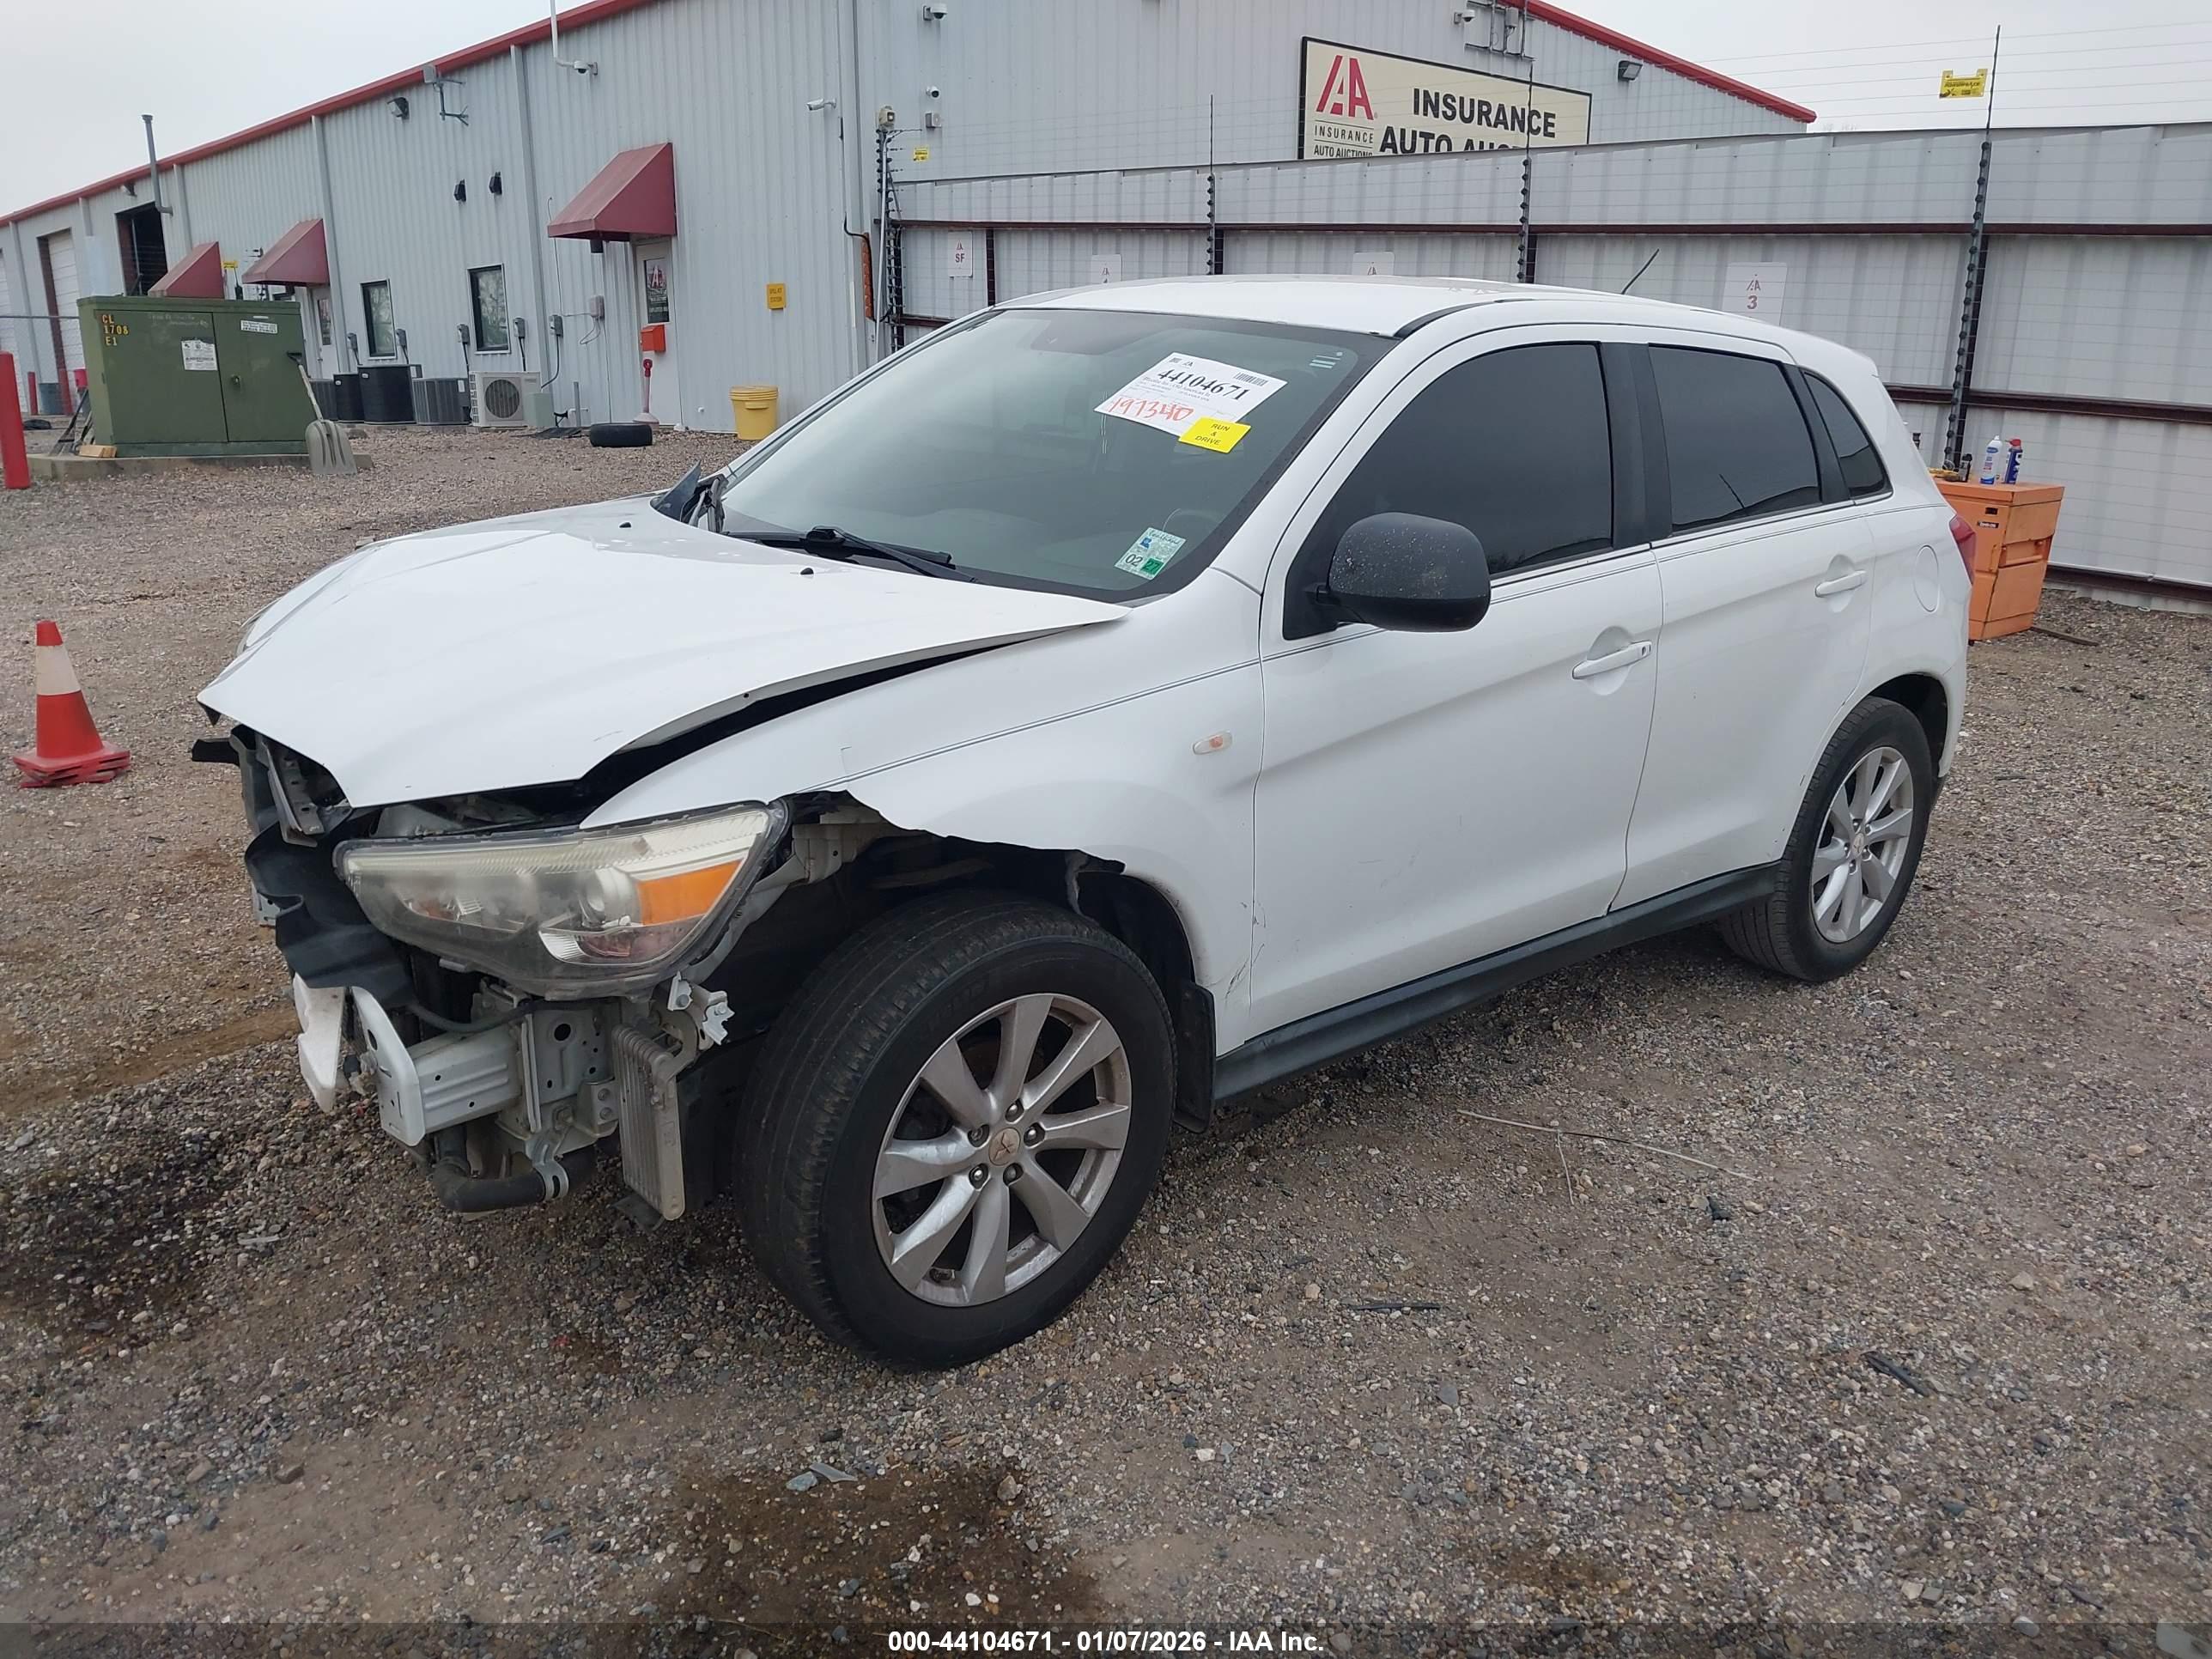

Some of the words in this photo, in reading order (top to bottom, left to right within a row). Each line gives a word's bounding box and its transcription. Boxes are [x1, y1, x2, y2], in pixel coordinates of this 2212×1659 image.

[1413, 88, 1556, 138] INSURANCE
[1315, 125, 1374, 144] INSURANCE
[1379, 125, 1453, 155] AUTO
[1314, 144, 1334, 158] AUTO
[955, 253, 965, 263] SF
[1747, 295, 1758, 309] 3
[102, 314, 114, 324] CL
[104, 325, 129, 335] 1708
[106, 336, 118, 346] E1
[1158, 368, 1251, 401] 44104671
[1211, 423, 1231, 432] RUN
[1194, 435, 1221, 446] DRIVE
[1125, 554, 1143, 568] 02
